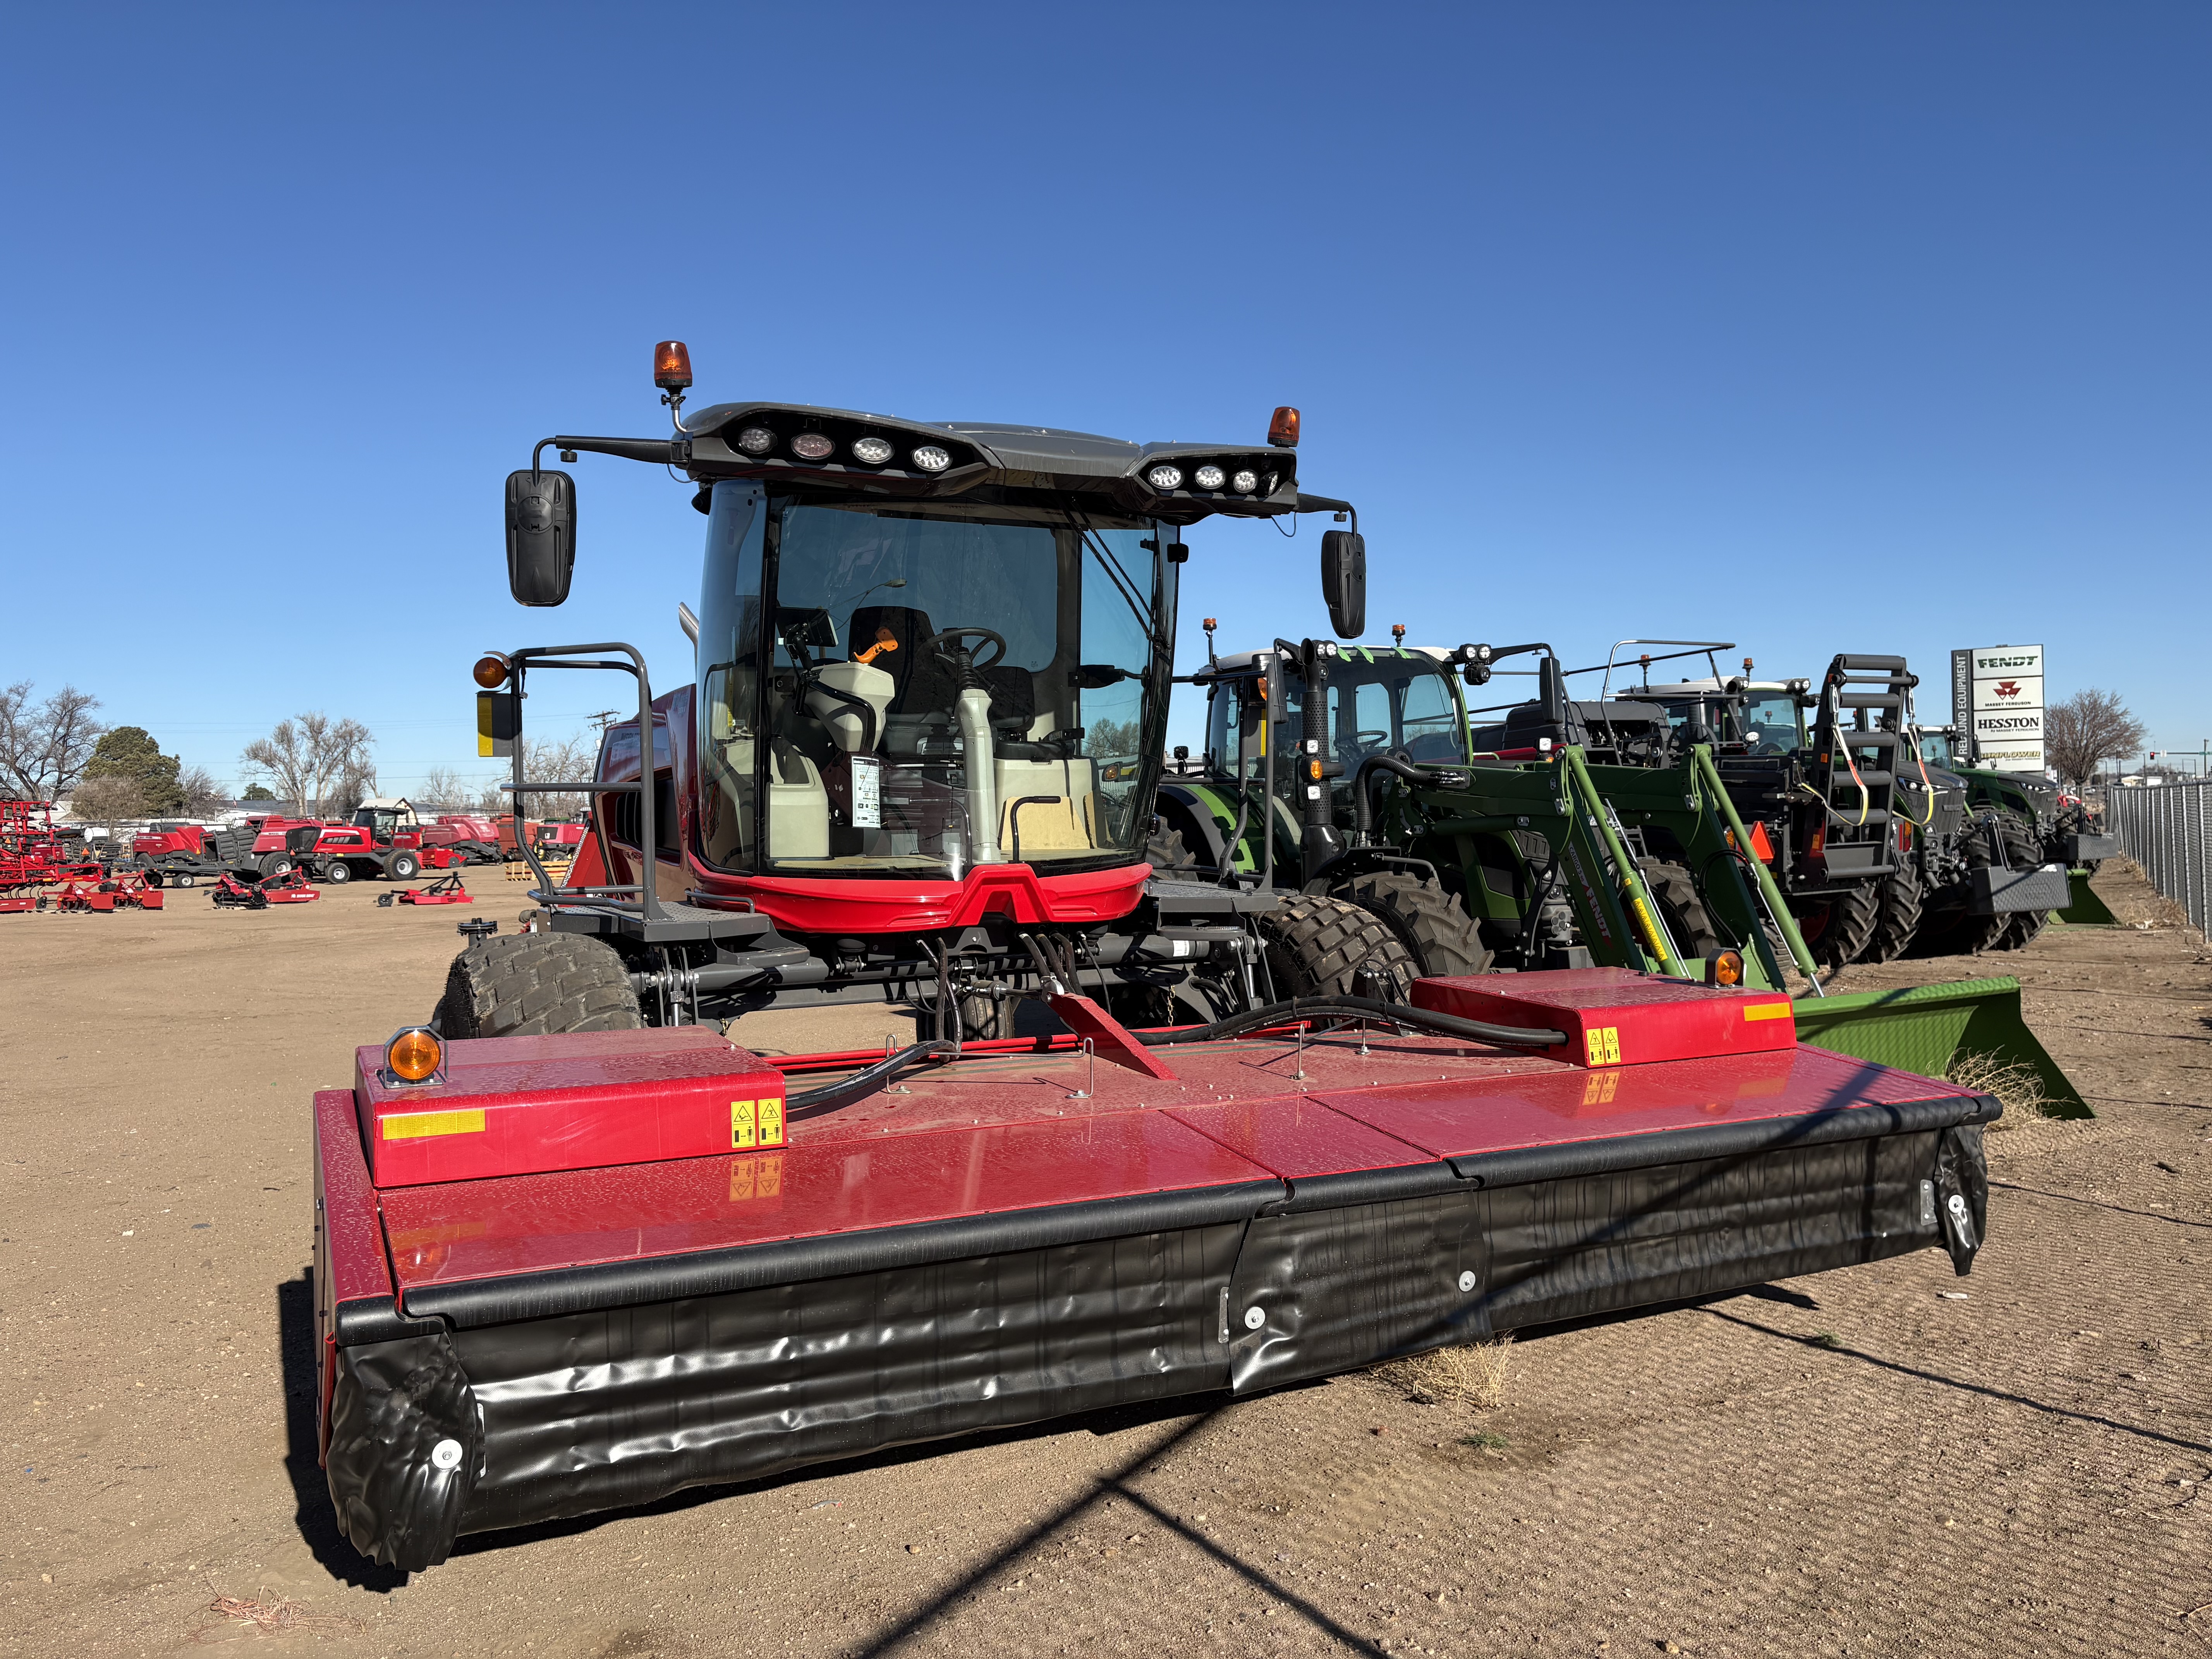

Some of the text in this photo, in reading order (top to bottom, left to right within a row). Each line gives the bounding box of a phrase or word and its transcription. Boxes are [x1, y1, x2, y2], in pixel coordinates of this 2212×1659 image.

[1977, 656, 2038, 668] FENDT
[1956, 655, 1967, 709] EQUIPMENT
[1978, 717, 2039, 729] HESSTON
[1569, 847, 1580, 869] CARGO
[1587, 887, 1611, 938] FENDT
